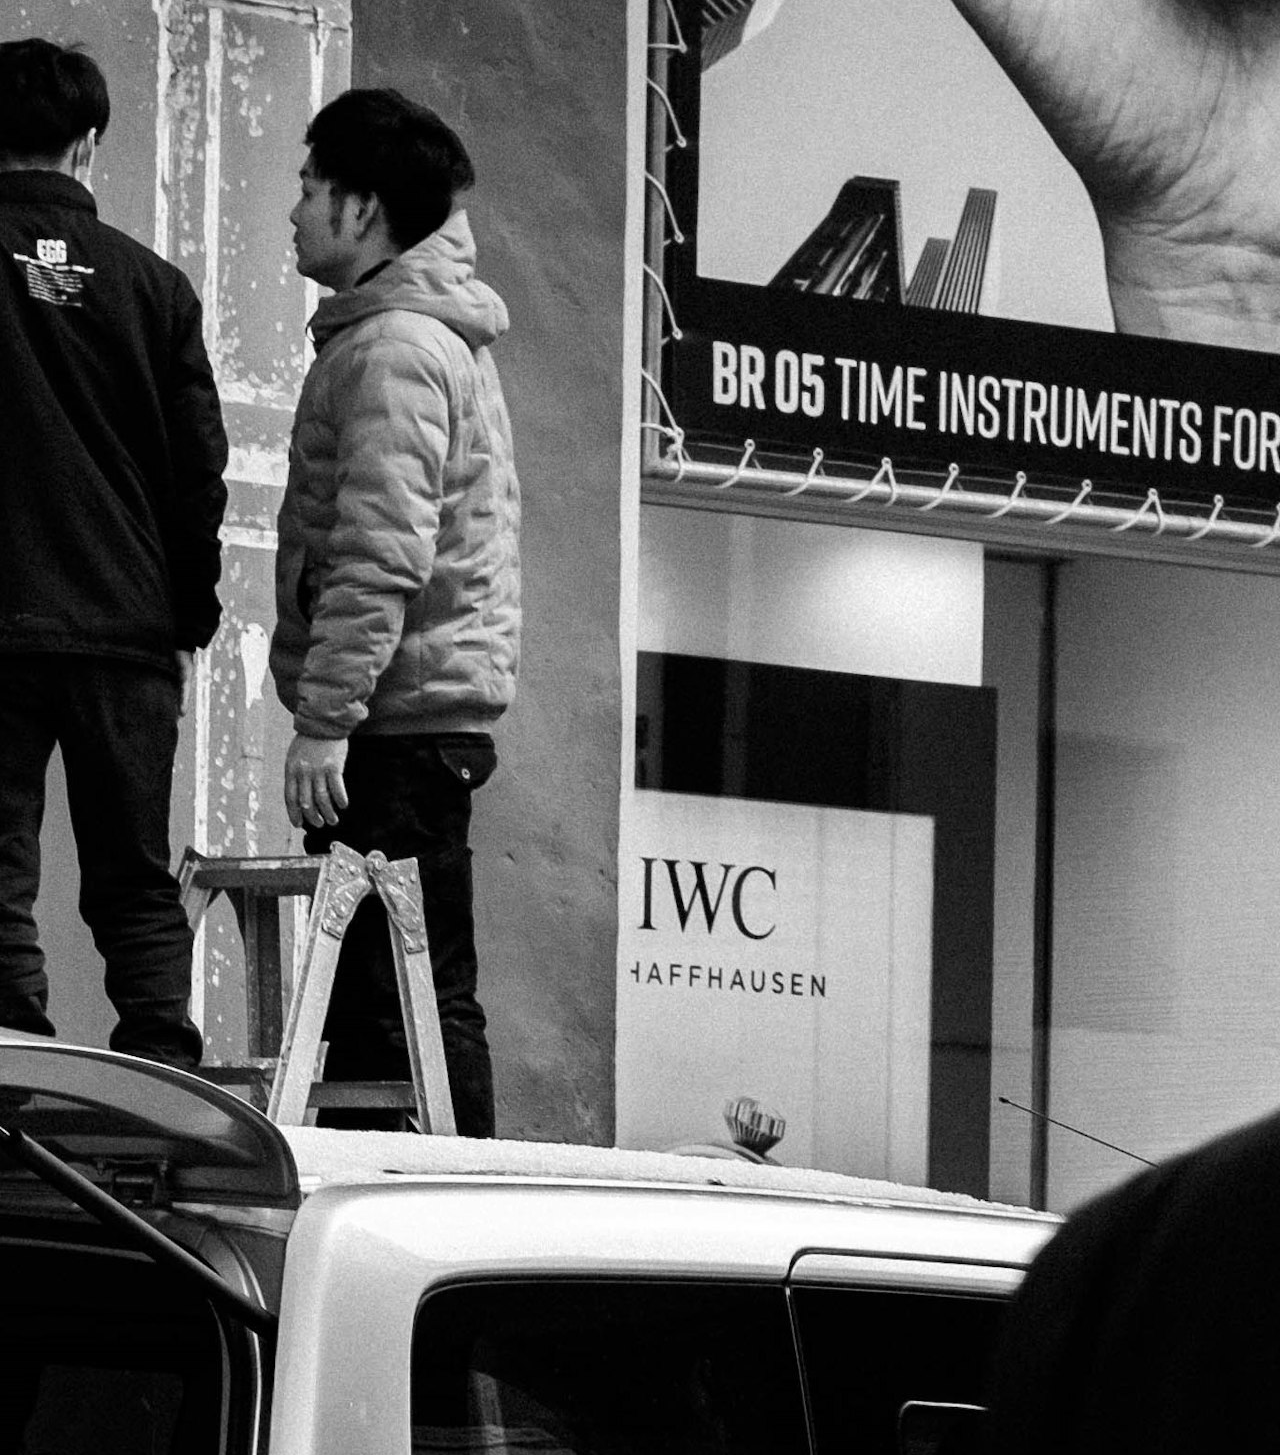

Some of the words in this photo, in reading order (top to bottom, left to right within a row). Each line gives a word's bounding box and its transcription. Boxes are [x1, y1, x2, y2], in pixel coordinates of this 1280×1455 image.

[711, 341, 766, 412] BR
[776, 349, 825, 419] 05
[835, 356, 927, 432] TIME
[938, 370, 1202, 466] INSTRUMENTS
[637, 857, 777, 940] IWC
